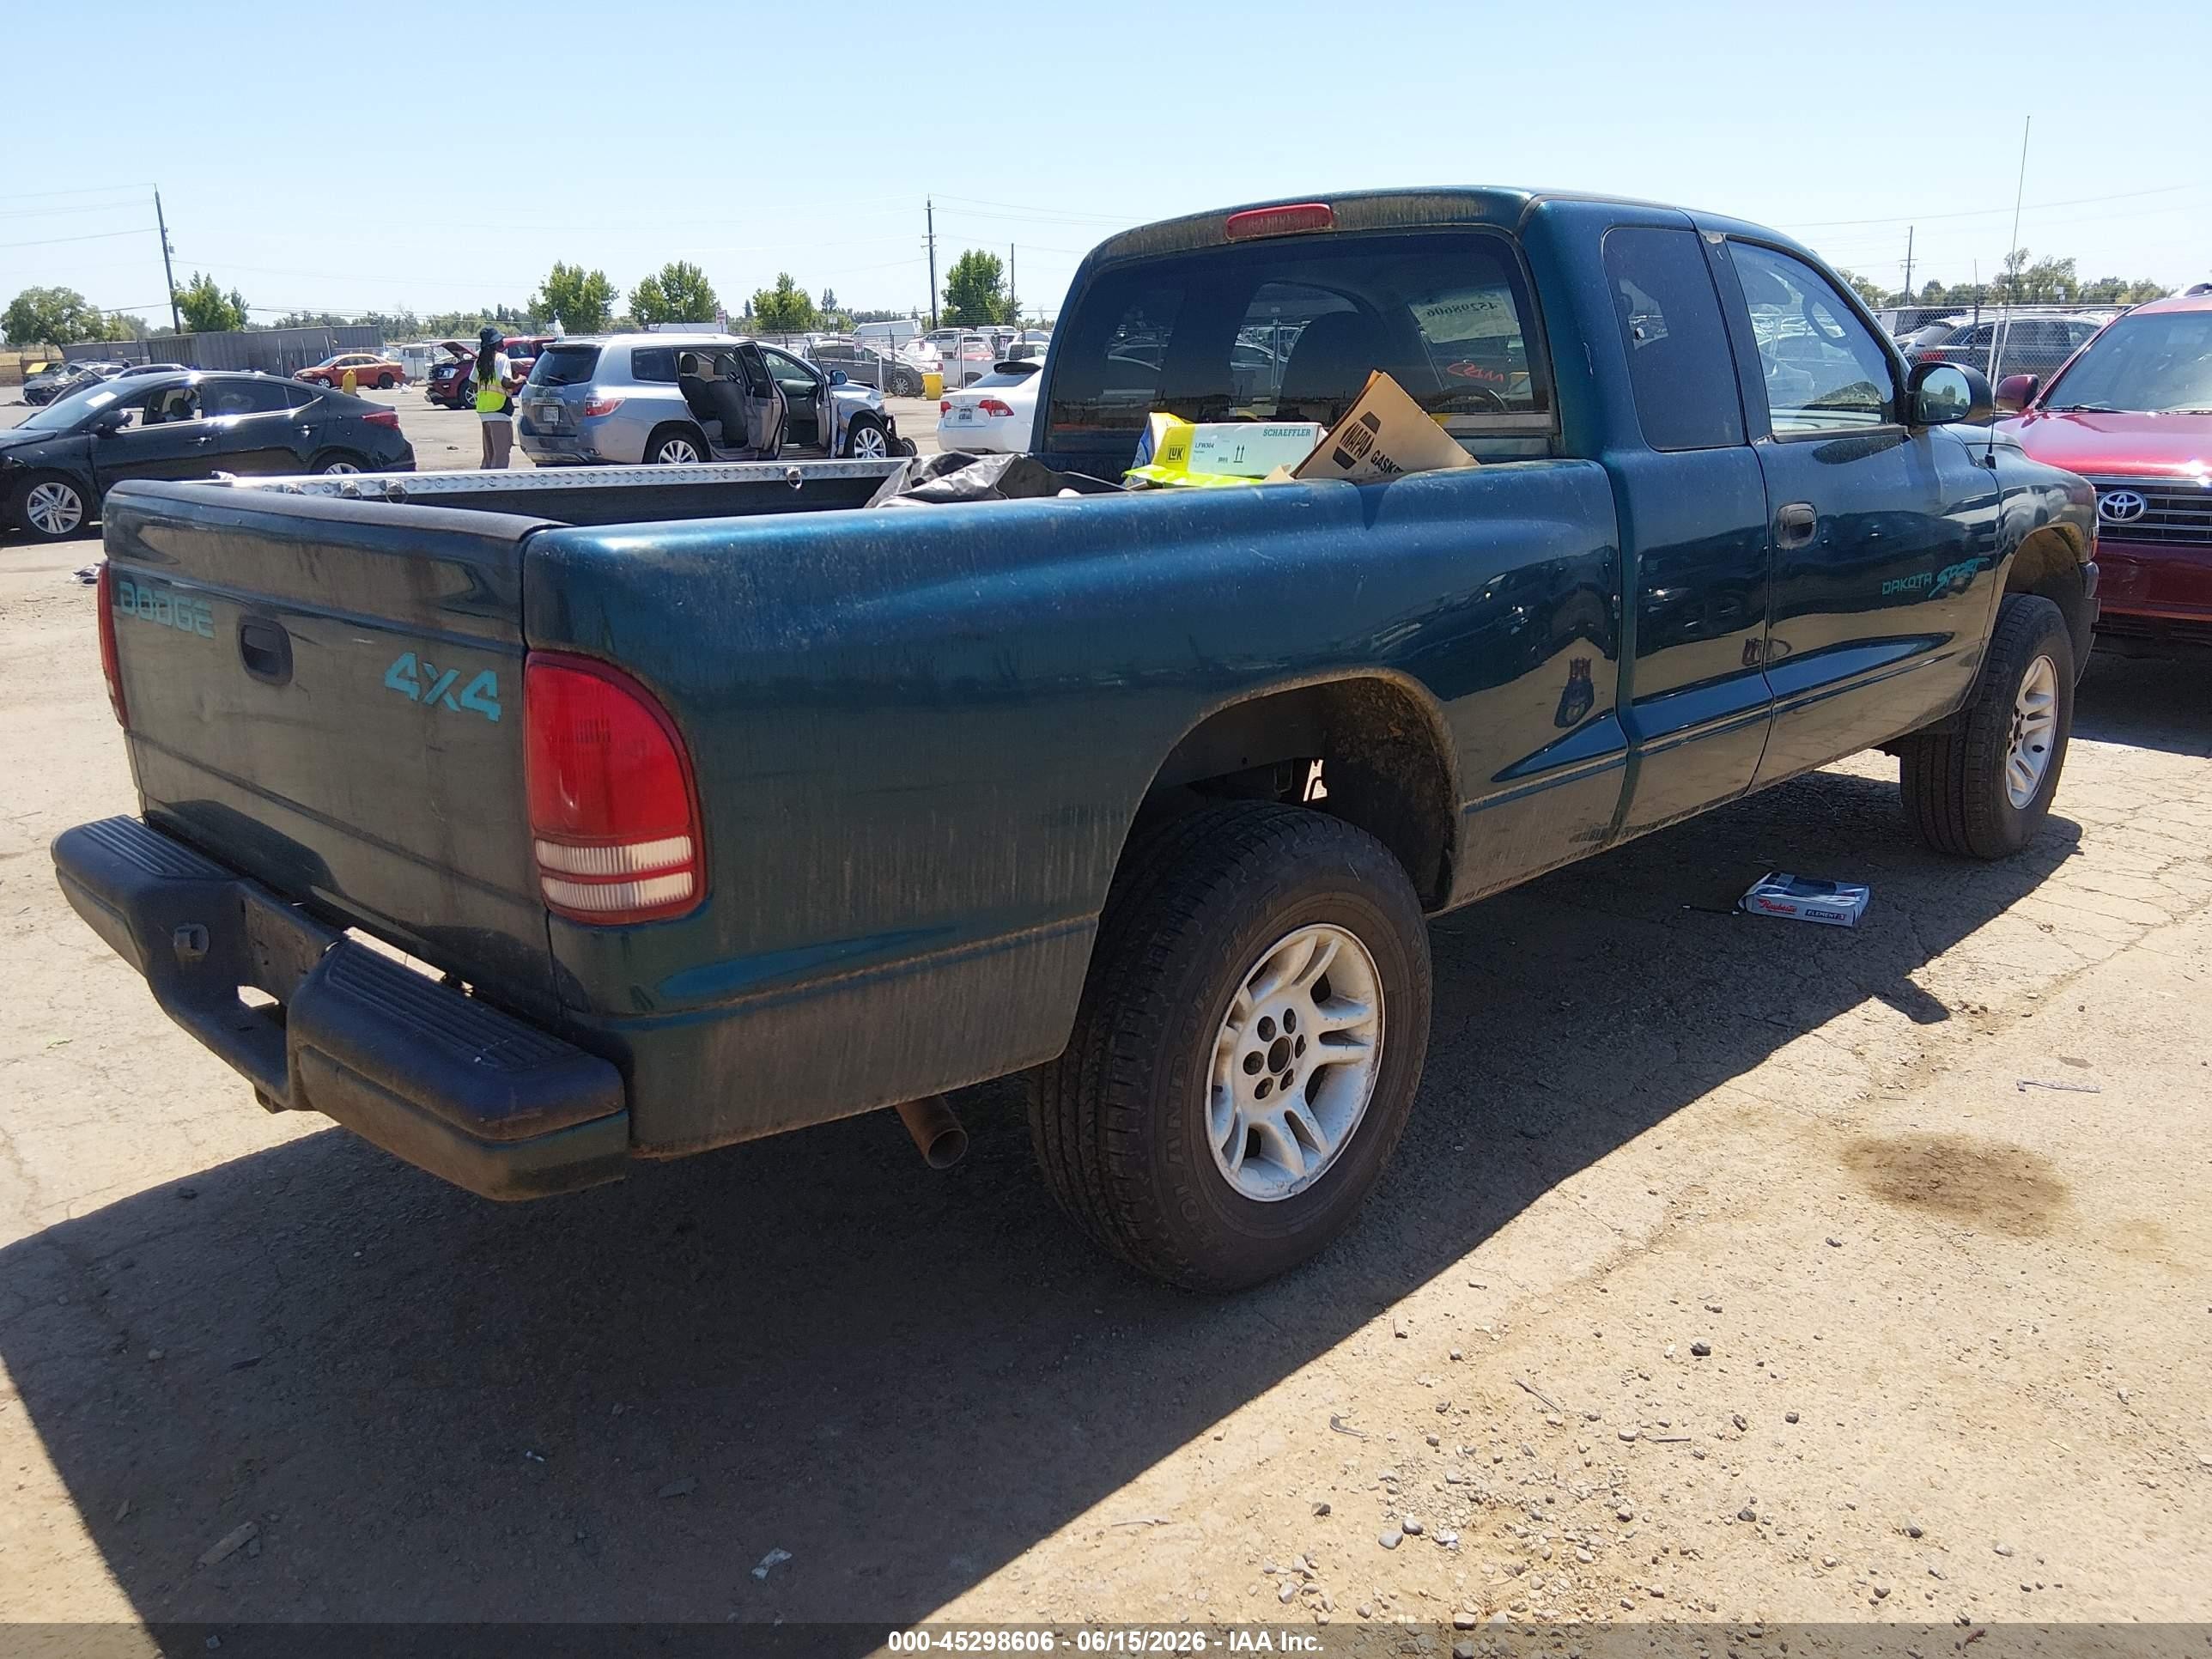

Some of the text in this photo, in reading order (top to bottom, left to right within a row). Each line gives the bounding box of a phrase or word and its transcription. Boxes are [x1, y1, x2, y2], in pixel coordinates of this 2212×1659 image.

[1263, 428, 1311, 437] SCHAEFFLER
[1340, 423, 1372, 459] NAPA
[1882, 573, 1932, 595] DAKOTA
[118, 580, 216, 640] DODGE
[1808, 910, 1837, 919] ELEMENT
